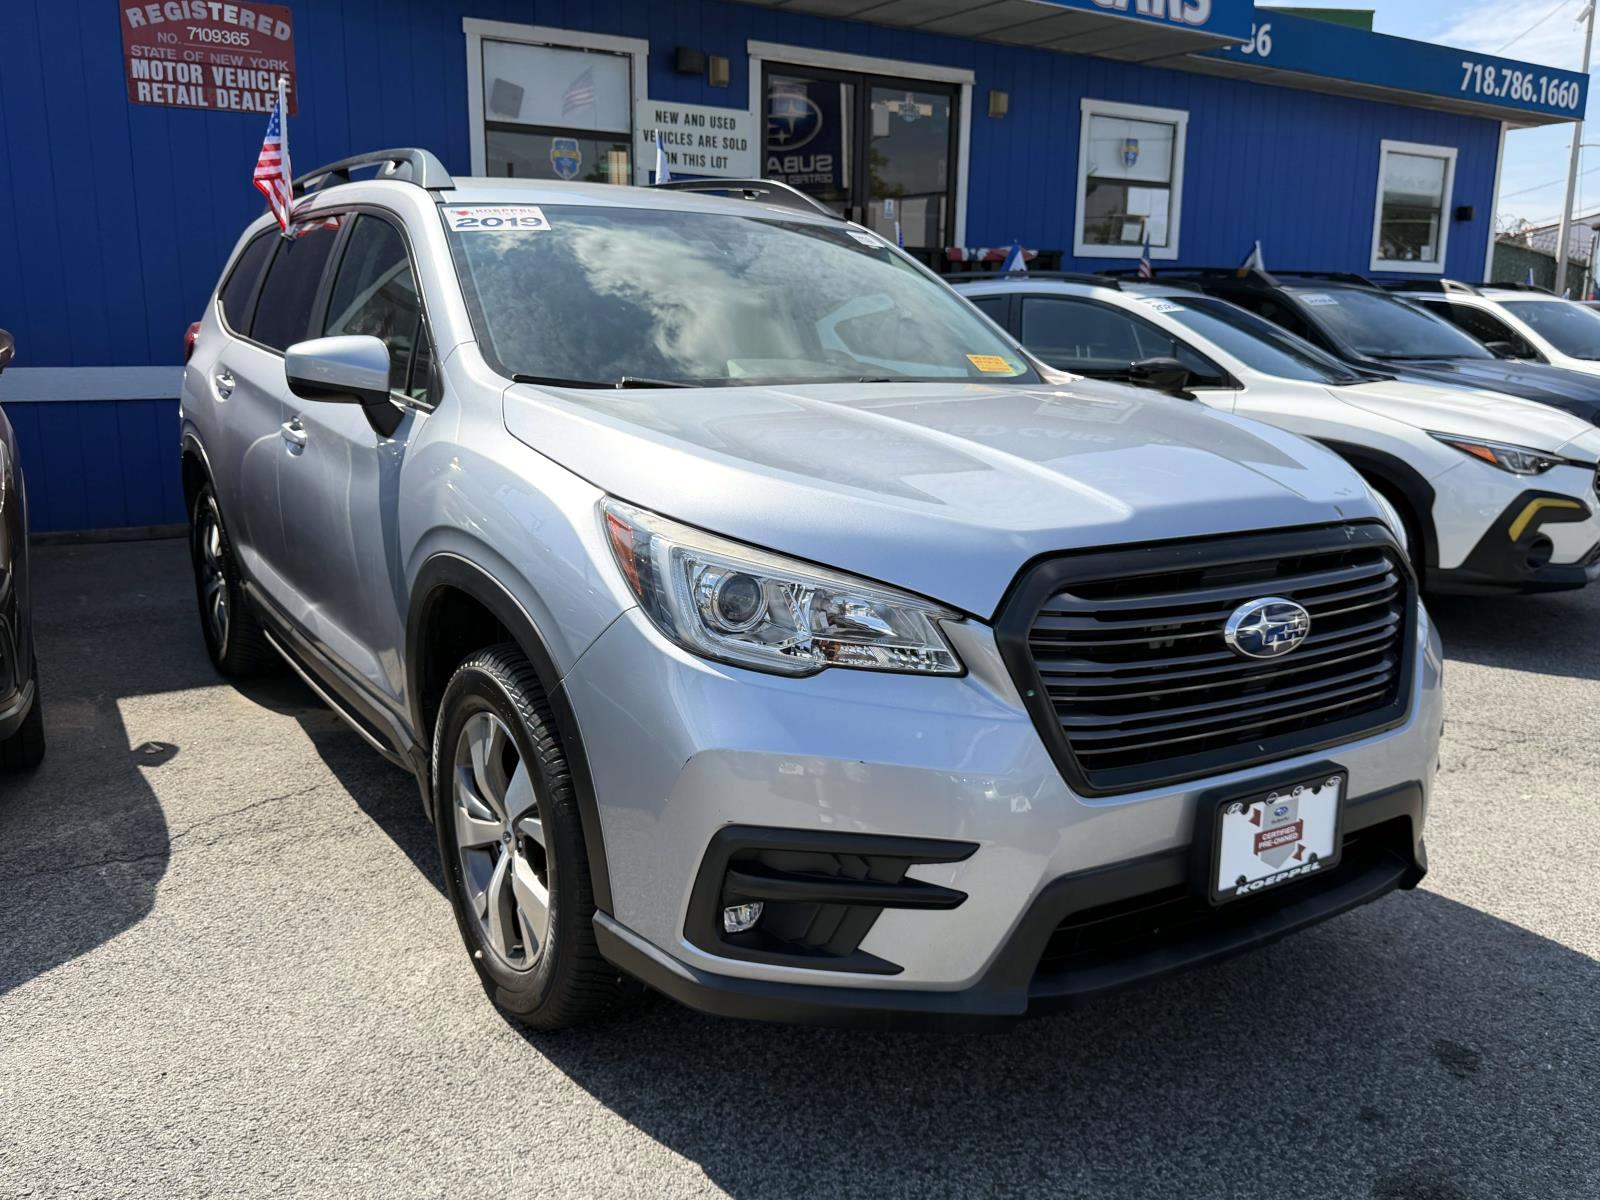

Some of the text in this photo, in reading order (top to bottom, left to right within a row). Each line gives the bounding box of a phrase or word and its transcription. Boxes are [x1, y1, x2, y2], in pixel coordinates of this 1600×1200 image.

[125, 0, 291, 41] REGISTERED
[157, 26, 250, 46] NO. 7109365
[131, 45, 289, 71] STATE OF NEW YORK
[131, 58, 292, 93] MOTOR VEHICLE
[1460, 61, 1579, 110] 718.786.1660
[137, 81, 208, 106] RETAIL
[655, 110, 736, 131] NEW AND USED
[698, 134, 718, 149] ARE
[722, 138, 747, 151] SOLD
[682, 153, 706, 168] THIS
[711, 156, 729, 170] LOT
[455, 217, 543, 228] 2019
[1261, 826, 1297, 841] CERTIFIED
[1236, 861, 1321, 895] KOEPPEL
